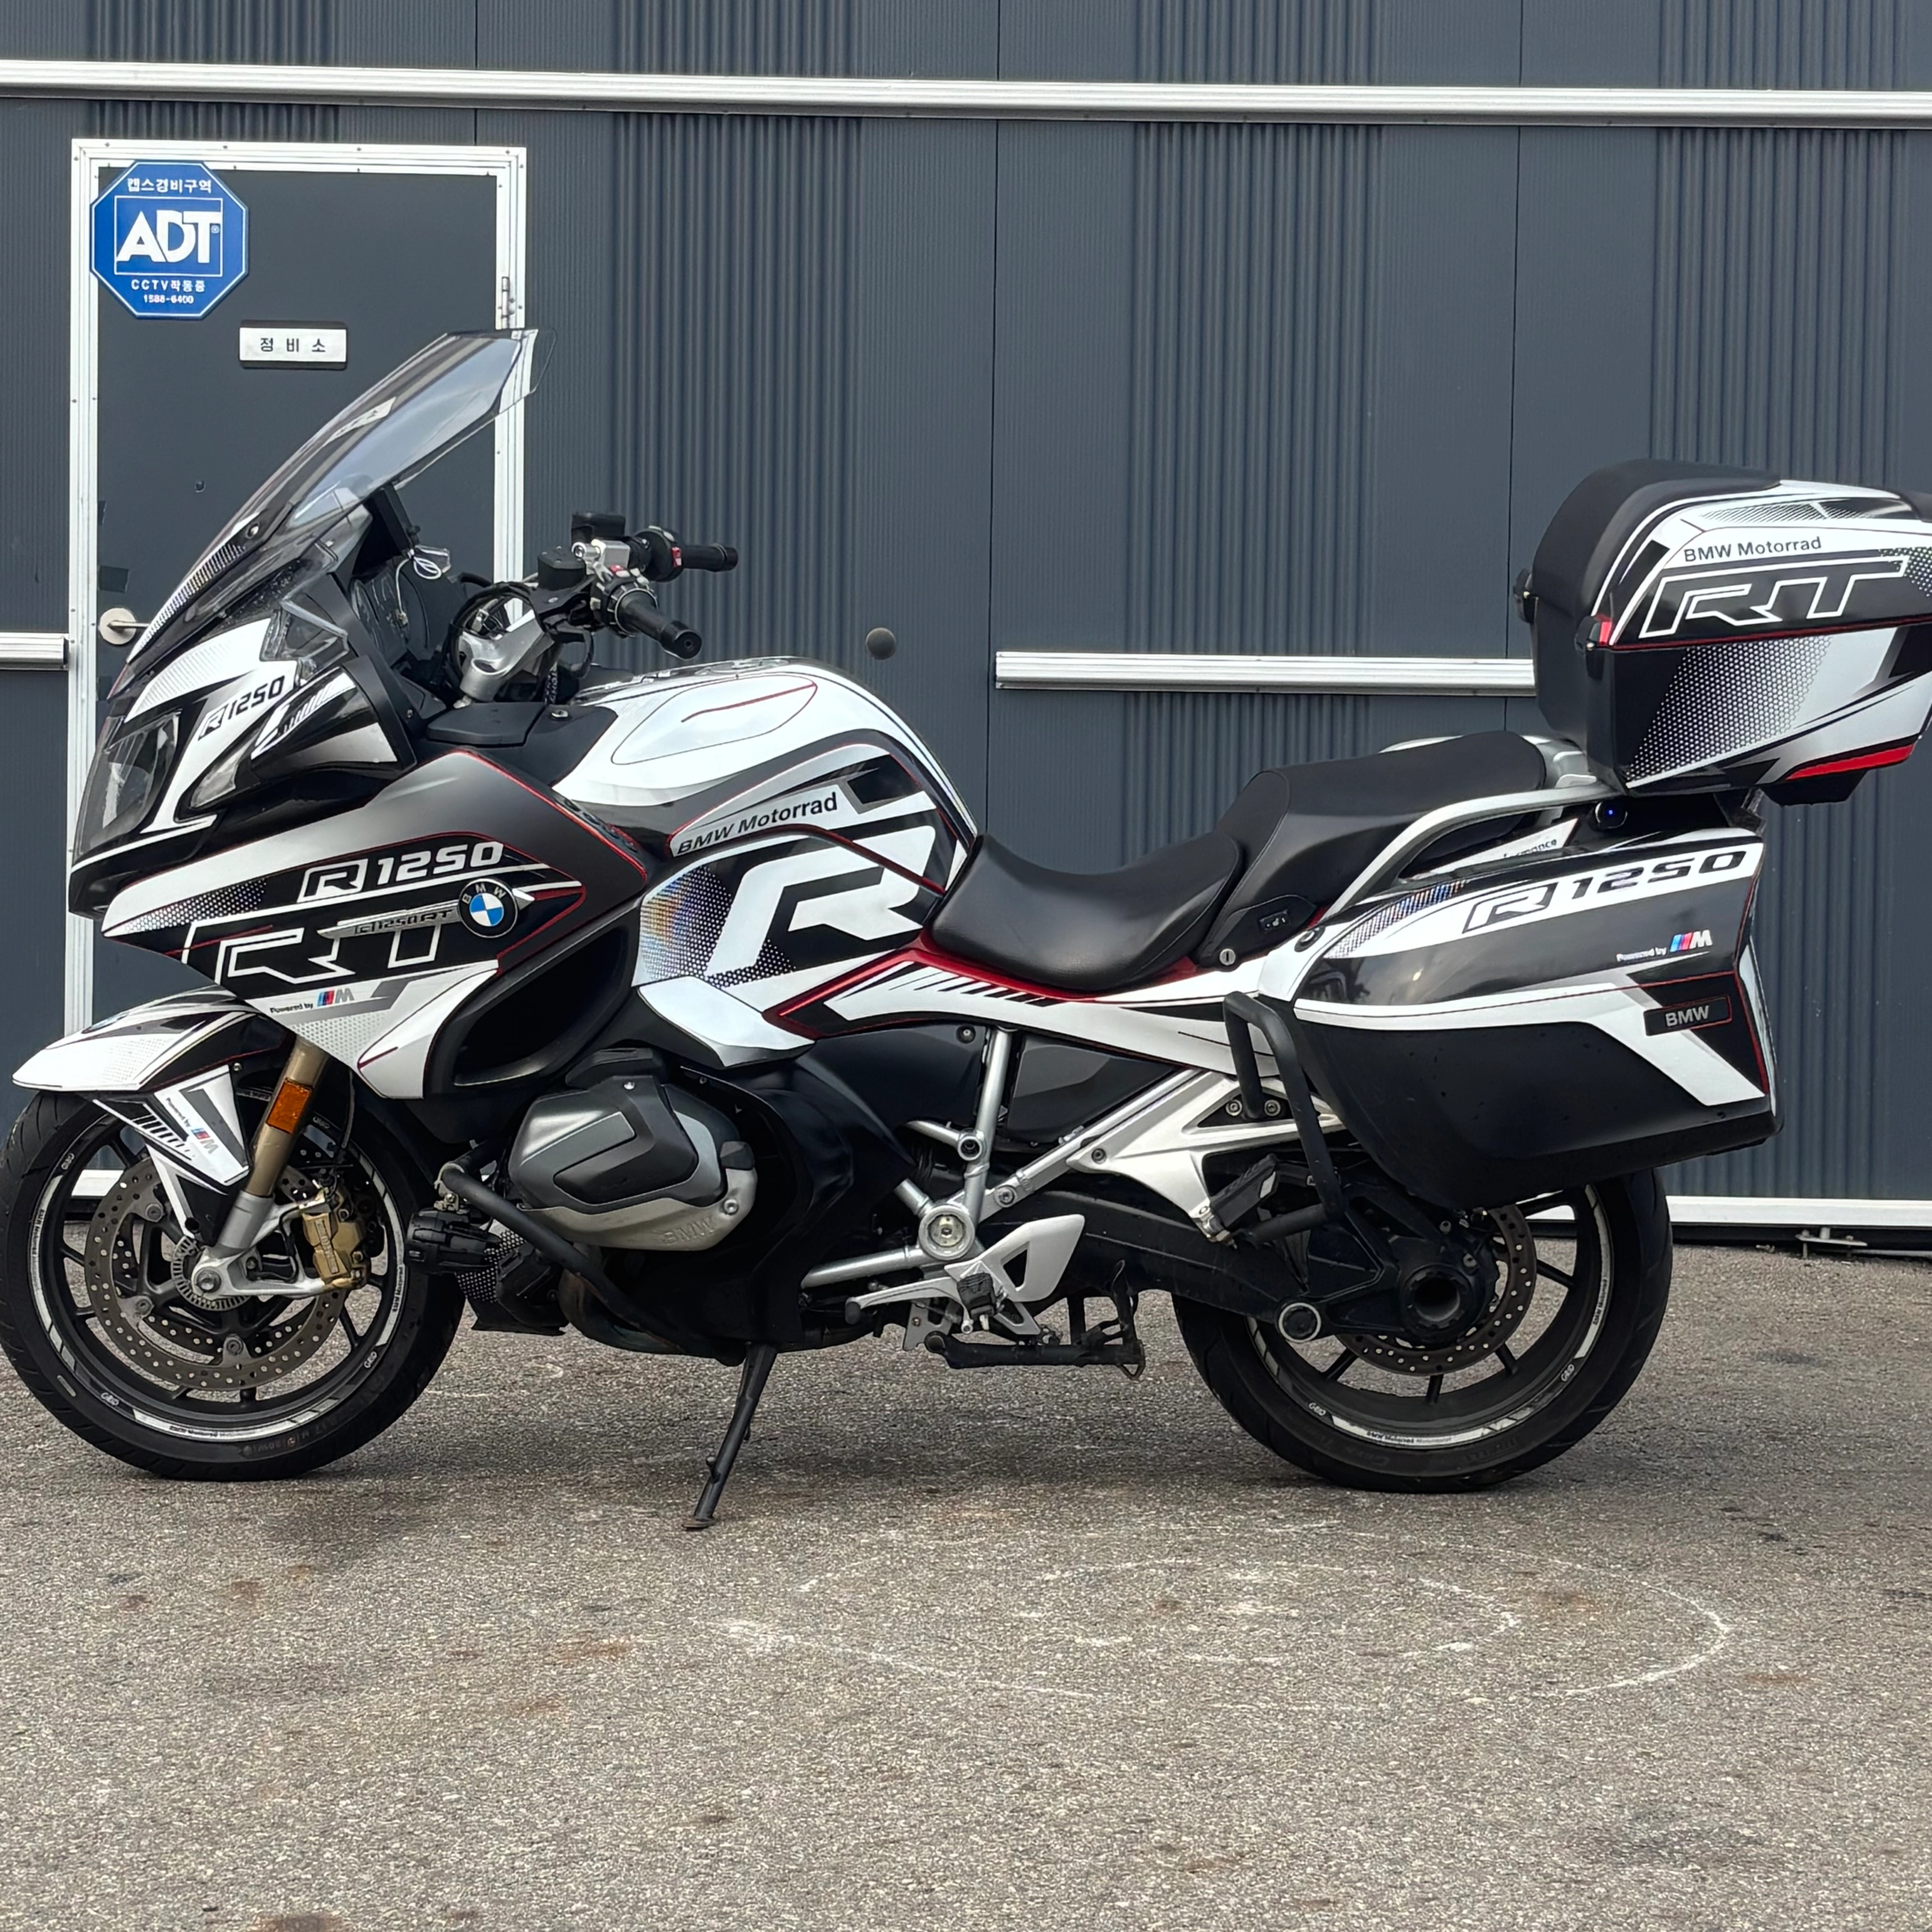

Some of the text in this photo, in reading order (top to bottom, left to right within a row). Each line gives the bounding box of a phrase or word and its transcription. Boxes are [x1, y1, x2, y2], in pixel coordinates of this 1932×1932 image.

[116, 210, 221, 263] ADT
[143, 294, 194, 304] 1588-6400
[1684, 537, 1822, 562] BMW Motorrad
[1639, 556, 1910, 639] RT
[677, 792, 837, 854] BMW Motorrad
[462, 883, 506, 905] BMW
[270, 1003, 303, 1013] Powered
[1665, 1006, 1709, 1028] BMW
[663, 1216, 714, 1247] BMW
